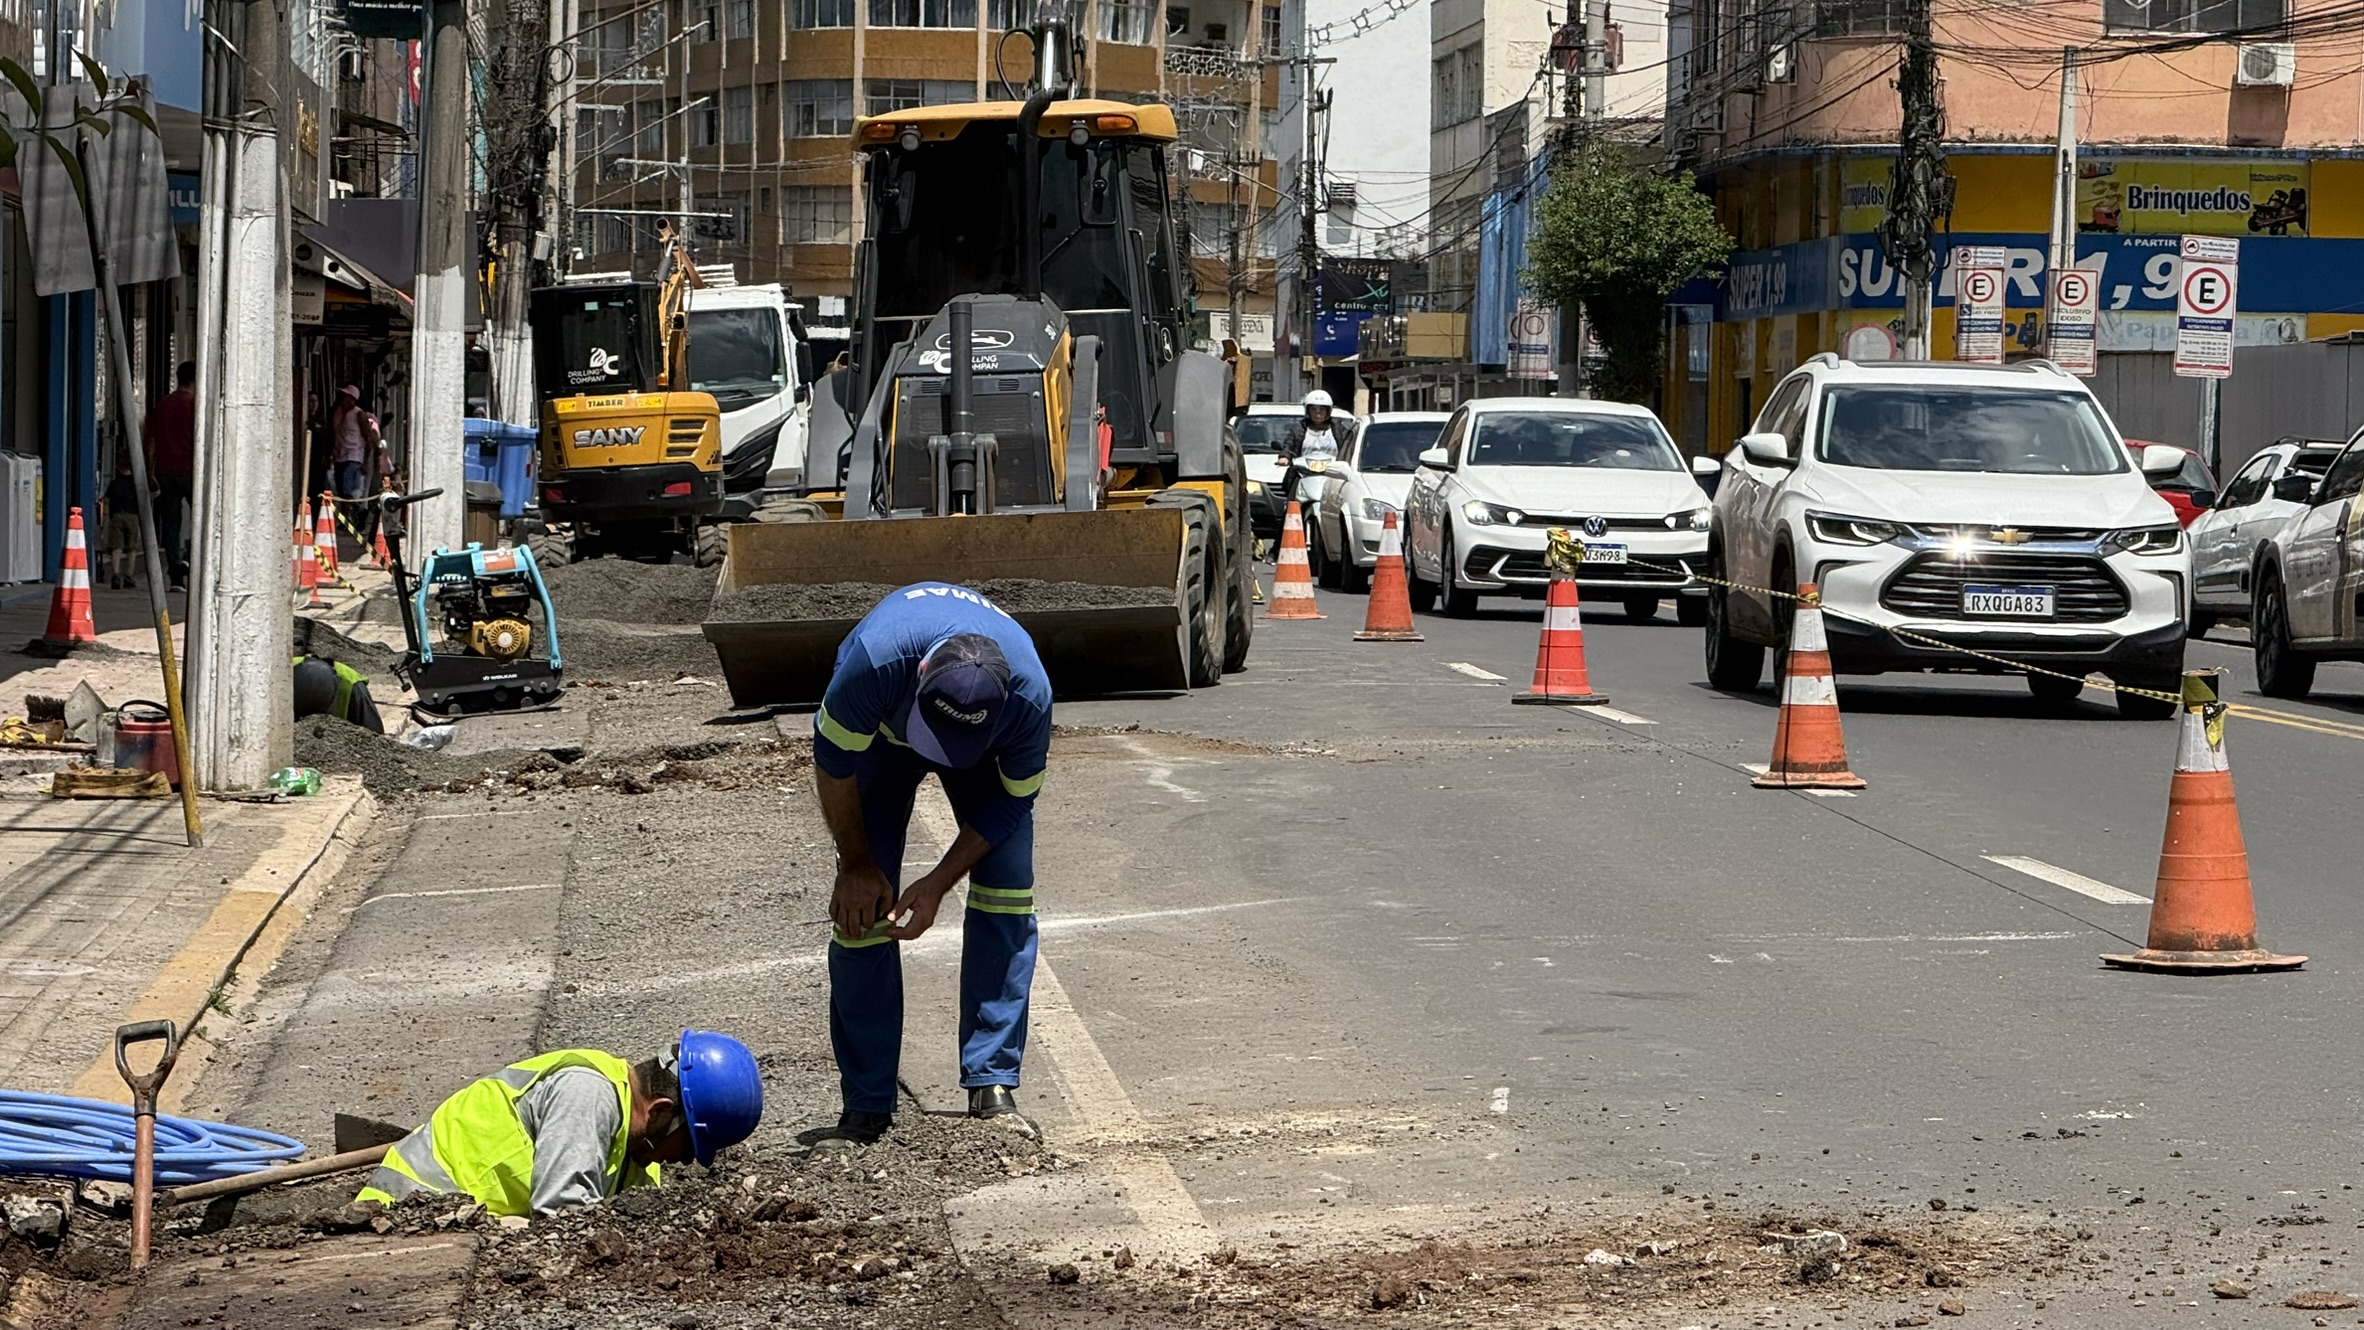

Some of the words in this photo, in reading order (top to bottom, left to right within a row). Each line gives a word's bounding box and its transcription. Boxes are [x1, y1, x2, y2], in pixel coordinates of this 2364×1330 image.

[2128, 186, 2250, 215] Brinquedos
[2123, 238, 2132, 247] A
[2134, 238, 2177, 247] PARTIR
[1839, 248, 2045, 298] SUR
[1729, 264, 1763, 311] SUPER
[1765, 261, 1787, 316] 1,99
[1972, 279, 1986, 296] E
[2065, 281, 2079, 299] E
[2199, 277, 2217, 304] E
[567, 368, 601, 379] DRILLING
[570, 374, 607, 385] COMPANY
[587, 399, 624, 408] TIMBER
[573, 426, 646, 449] SANY
